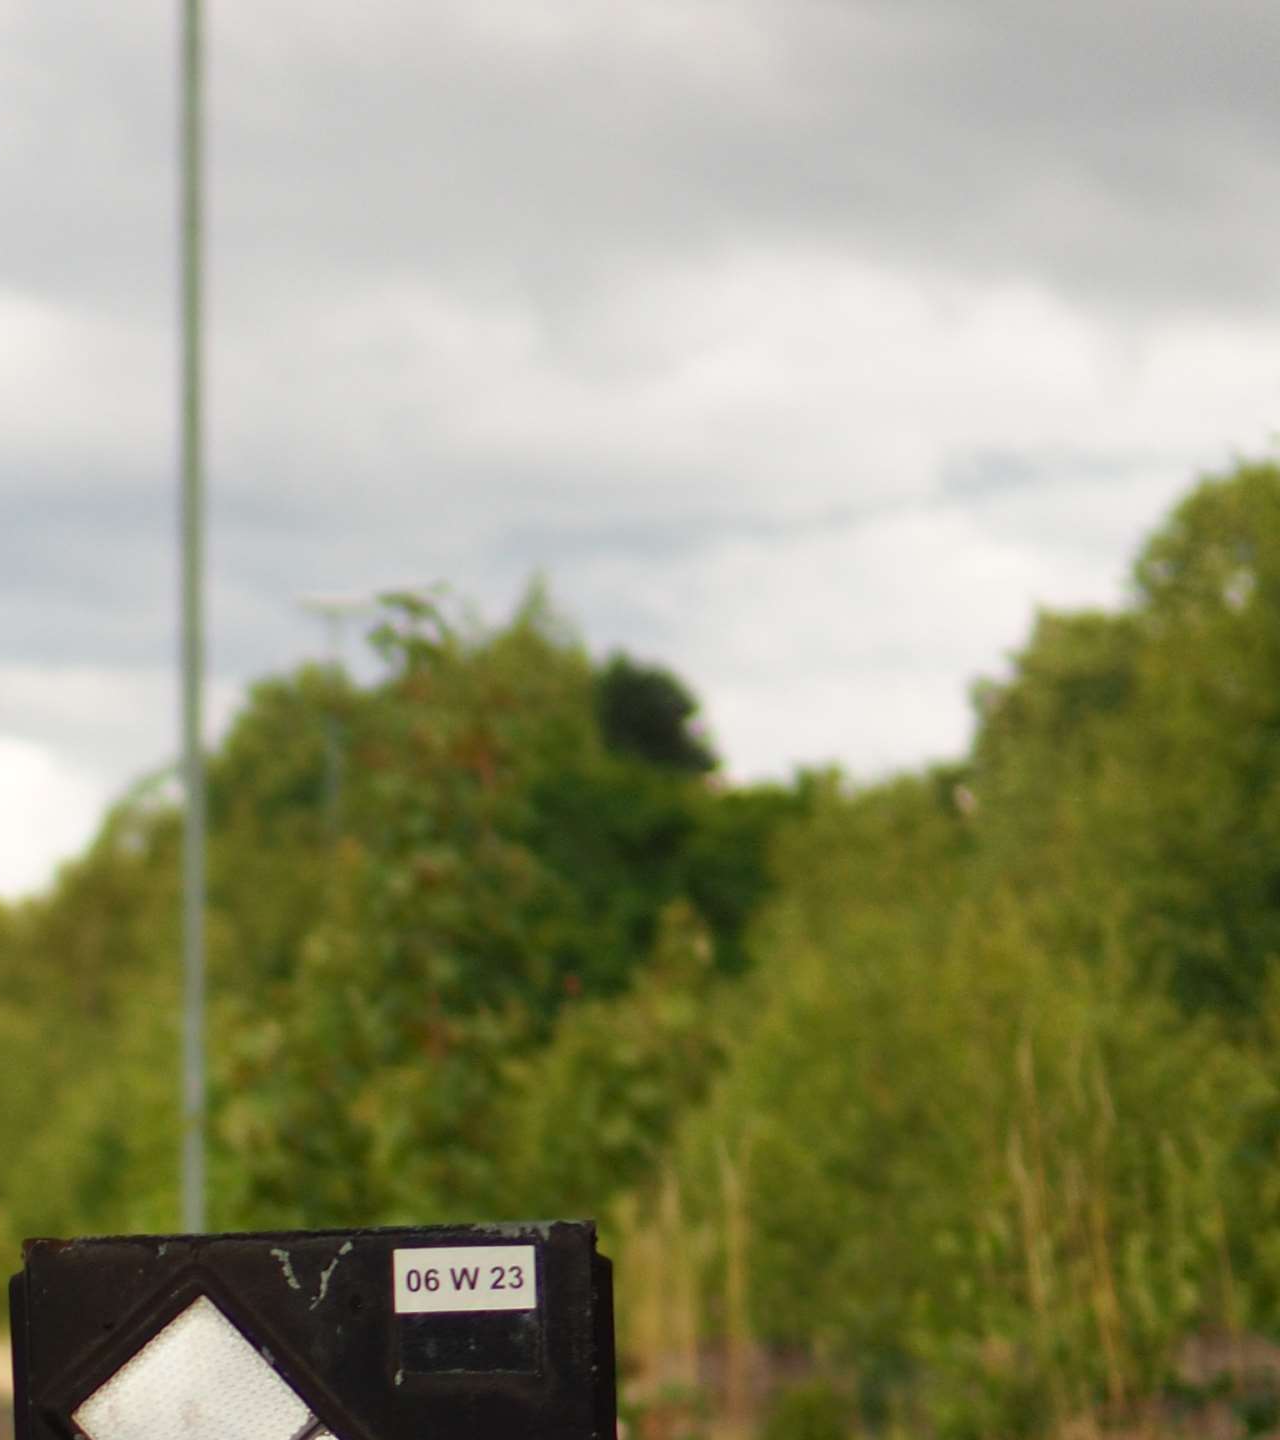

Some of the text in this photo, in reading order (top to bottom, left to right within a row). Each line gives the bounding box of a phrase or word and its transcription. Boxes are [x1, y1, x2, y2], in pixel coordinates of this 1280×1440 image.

[406, 1265, 524, 1292] 06 W 23
